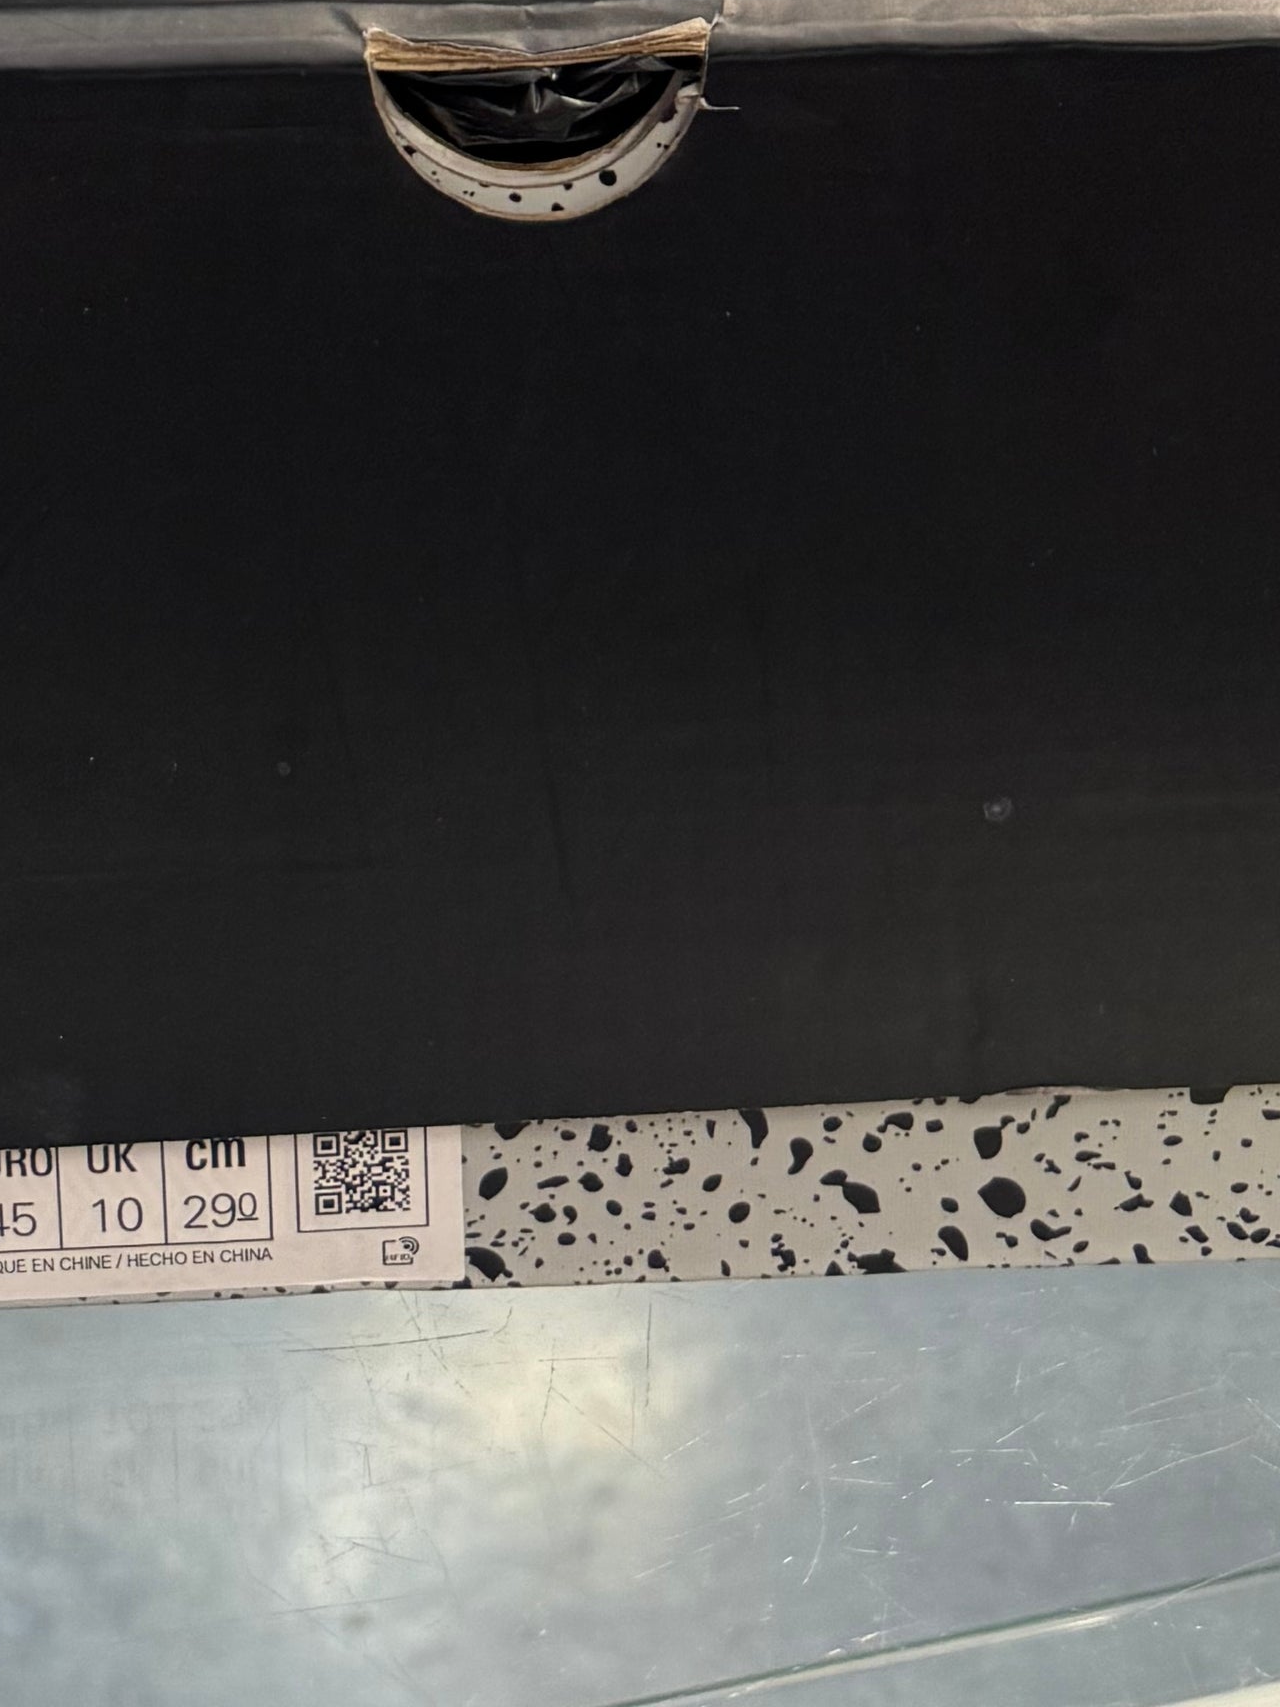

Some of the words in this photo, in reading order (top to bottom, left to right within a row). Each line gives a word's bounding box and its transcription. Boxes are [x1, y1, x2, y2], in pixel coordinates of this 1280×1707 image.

[87, 1143, 137, 1174] UK
[185, 1137, 246, 1171] cm
[92, 1197, 144, 1233] 10
[32, 1257, 54, 1273] EN
[59, 1254, 113, 1271] CHINE
[127, 1251, 188, 1268] HECHO
[192, 1250, 215, 1265] EN
[220, 1247, 273, 1263] CHINA
